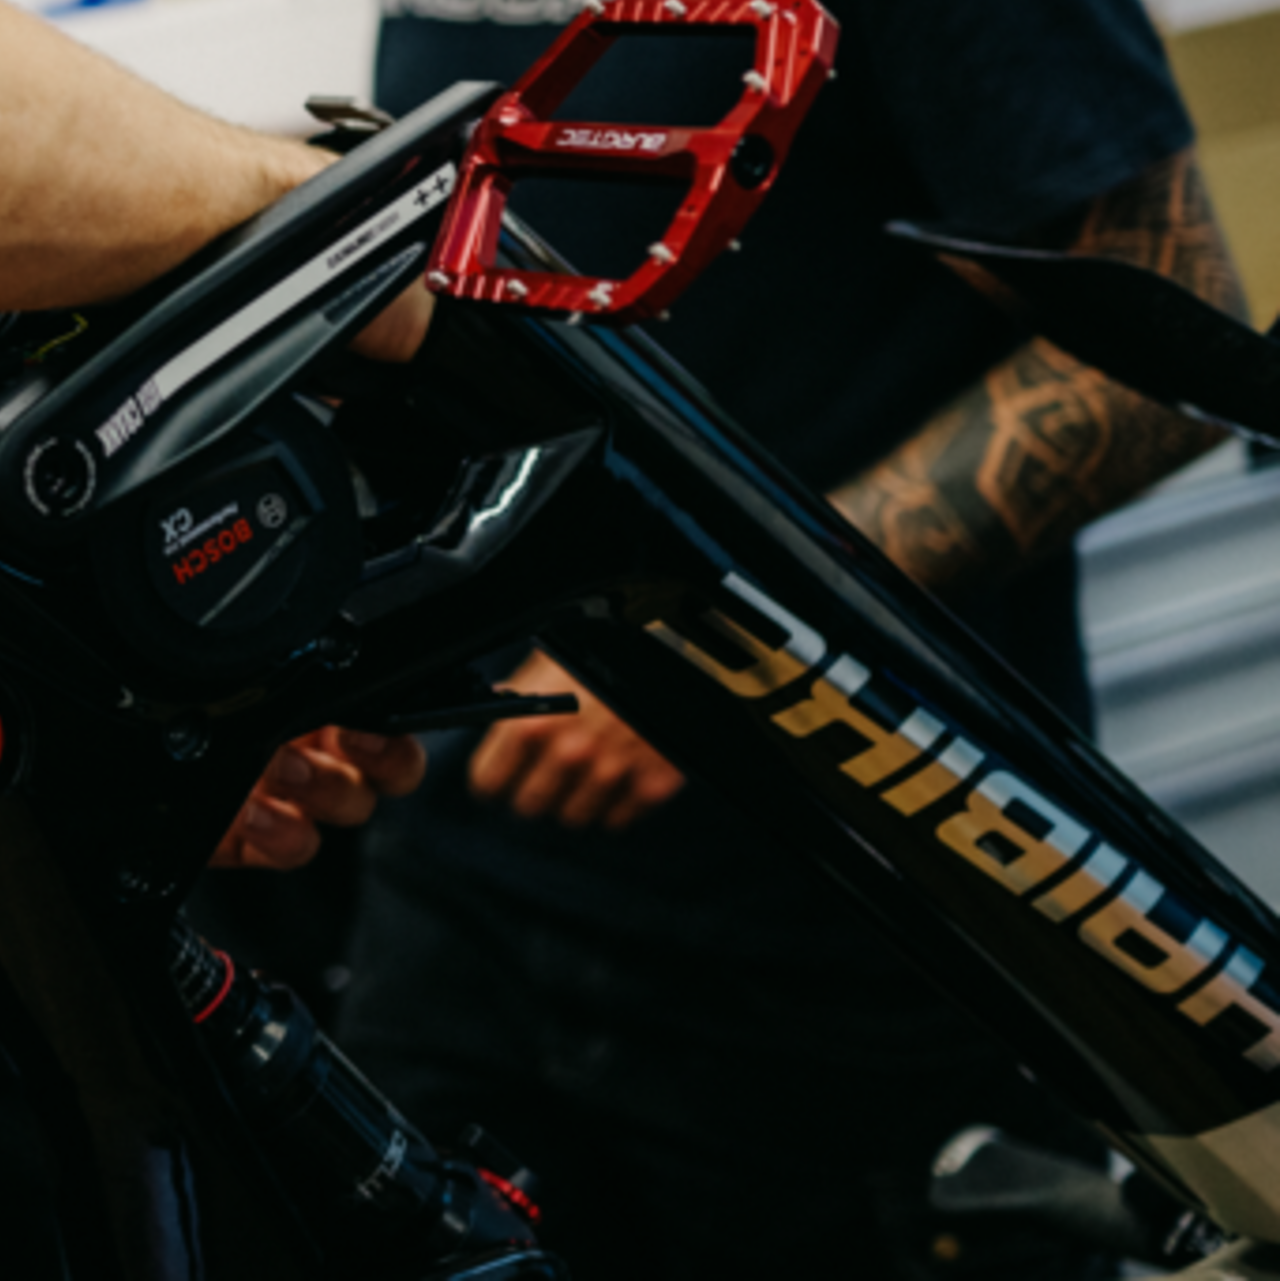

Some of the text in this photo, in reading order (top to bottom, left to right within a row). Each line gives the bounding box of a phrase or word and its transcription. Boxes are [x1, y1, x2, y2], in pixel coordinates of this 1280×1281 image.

[555, 128, 667, 152] BURGTEC
[160, 506, 194, 544] CX
[172, 517, 253, 584] BOSCH
[644, 570, 1280, 1070] HAIBIKE
